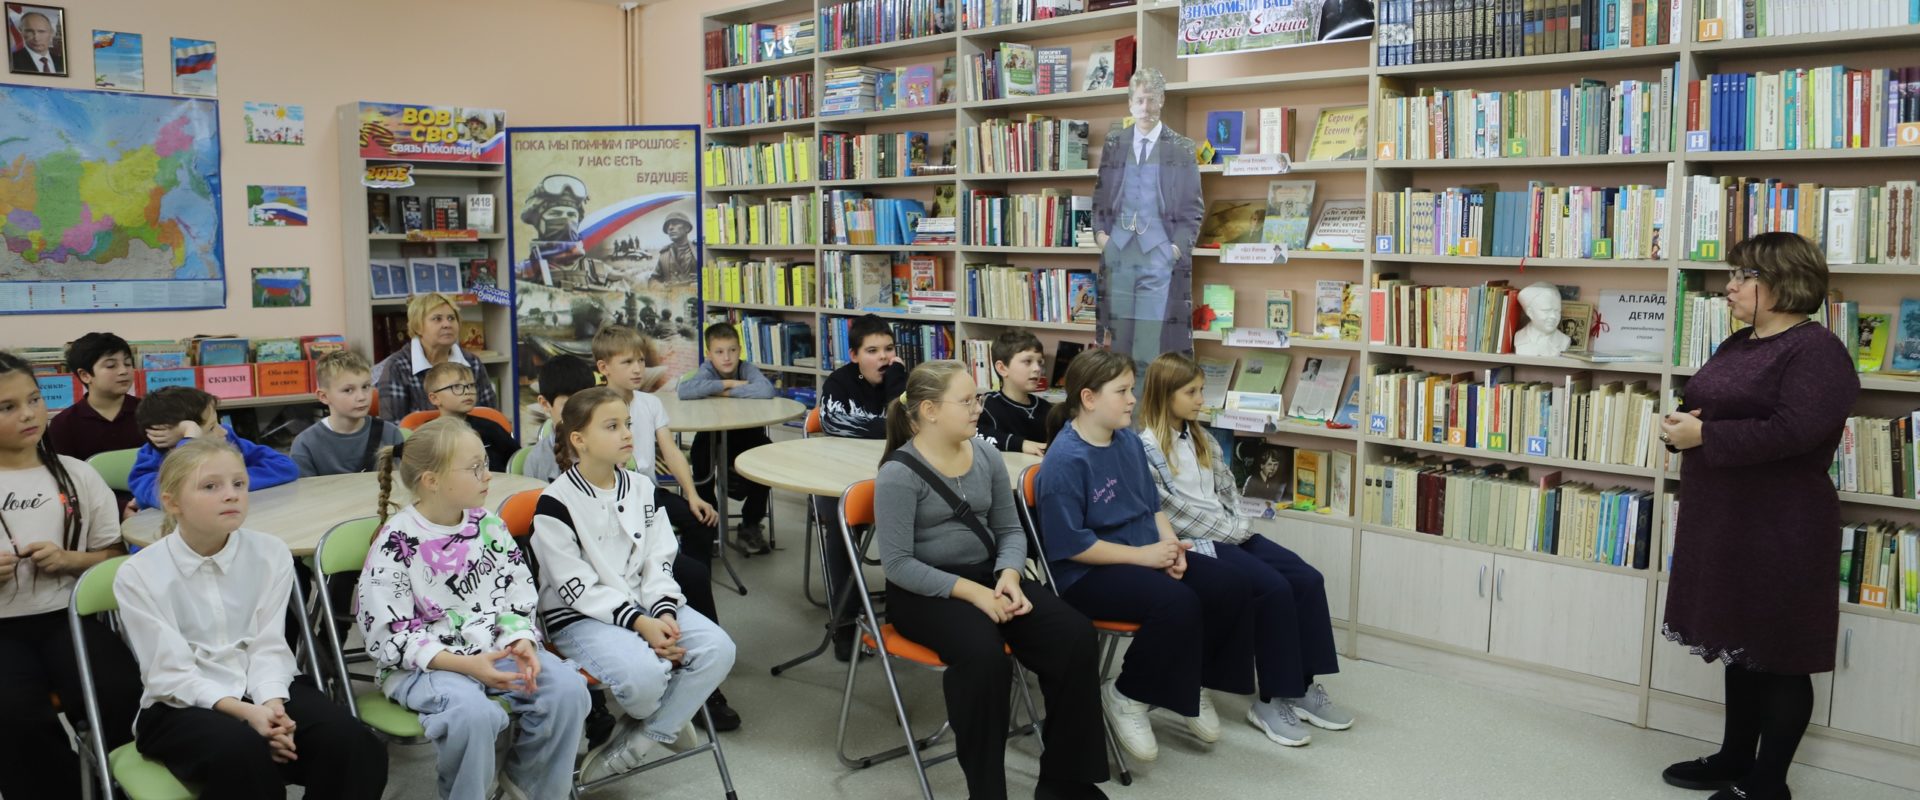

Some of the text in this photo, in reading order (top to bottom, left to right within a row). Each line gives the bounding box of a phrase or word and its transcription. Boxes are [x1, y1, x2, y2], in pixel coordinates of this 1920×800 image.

[1185, 13, 1309, 46] Сергей Есенин
[1703, 22, 1717, 38] Л
[402, 107, 451, 126] ВОВ
[1327, 113, 1354, 124] Сергей
[410, 126, 458, 143] СВО
[1324, 125, 1350, 135] Есенин
[1902, 127, 1919, 142] О
[515, 140, 545, 151] ПОКА
[549, 140, 569, 150] МЫ
[572, 139, 622, 150] ПОМНИМ
[625, 138, 679, 149] ПРОШЛОЕ
[1512, 142, 1523, 154] Б
[1691, 135, 1703, 148] Н
[1382, 144, 1391, 157] А
[578, 156, 642, 167] У НАС ЕСТЬ
[367, 167, 409, 182] 2025
[637, 171, 688, 184] БУДУЩЕЕ
[470, 197, 491, 207] 1418
[1380, 239, 1389, 250] В
[1464, 241, 1473, 253] Г
[1594, 241, 1607, 256] Д
[1701, 243, 1715, 257] П
[1619, 294, 1667, 305] А.П.ГАЙД
[1628, 311, 1664, 320] ДЕТЯМ
[208, 375, 246, 384] сказки
[1371, 417, 1385, 428] Ж
[1490, 435, 1501, 447] И
[1531, 440, 1542, 452] К
[0, 492, 52, 511] love
[445, 539, 504, 601] Fantastic
